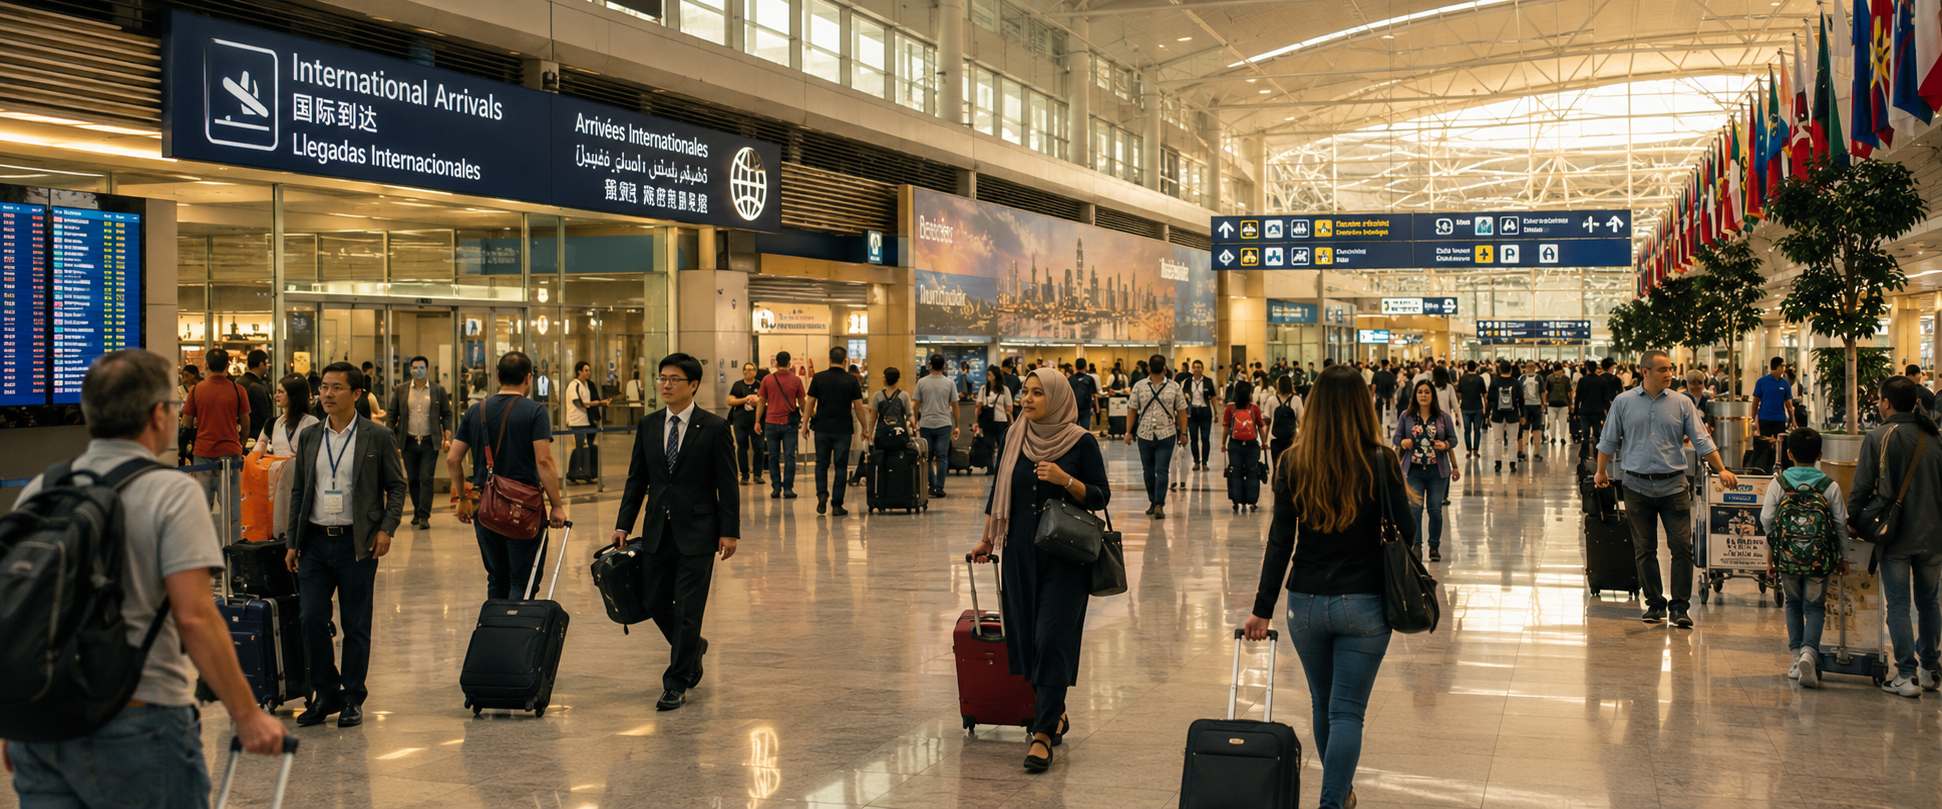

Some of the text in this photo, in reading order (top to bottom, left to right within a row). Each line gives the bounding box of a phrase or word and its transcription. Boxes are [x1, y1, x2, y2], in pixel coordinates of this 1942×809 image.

[293, 52, 503, 120] International Arrivals
[293, 92, 378, 133] 国际到达
[575, 112, 709, 159] Arrivées Internationales
[293, 132, 481, 180] Llegadas Internacionales
